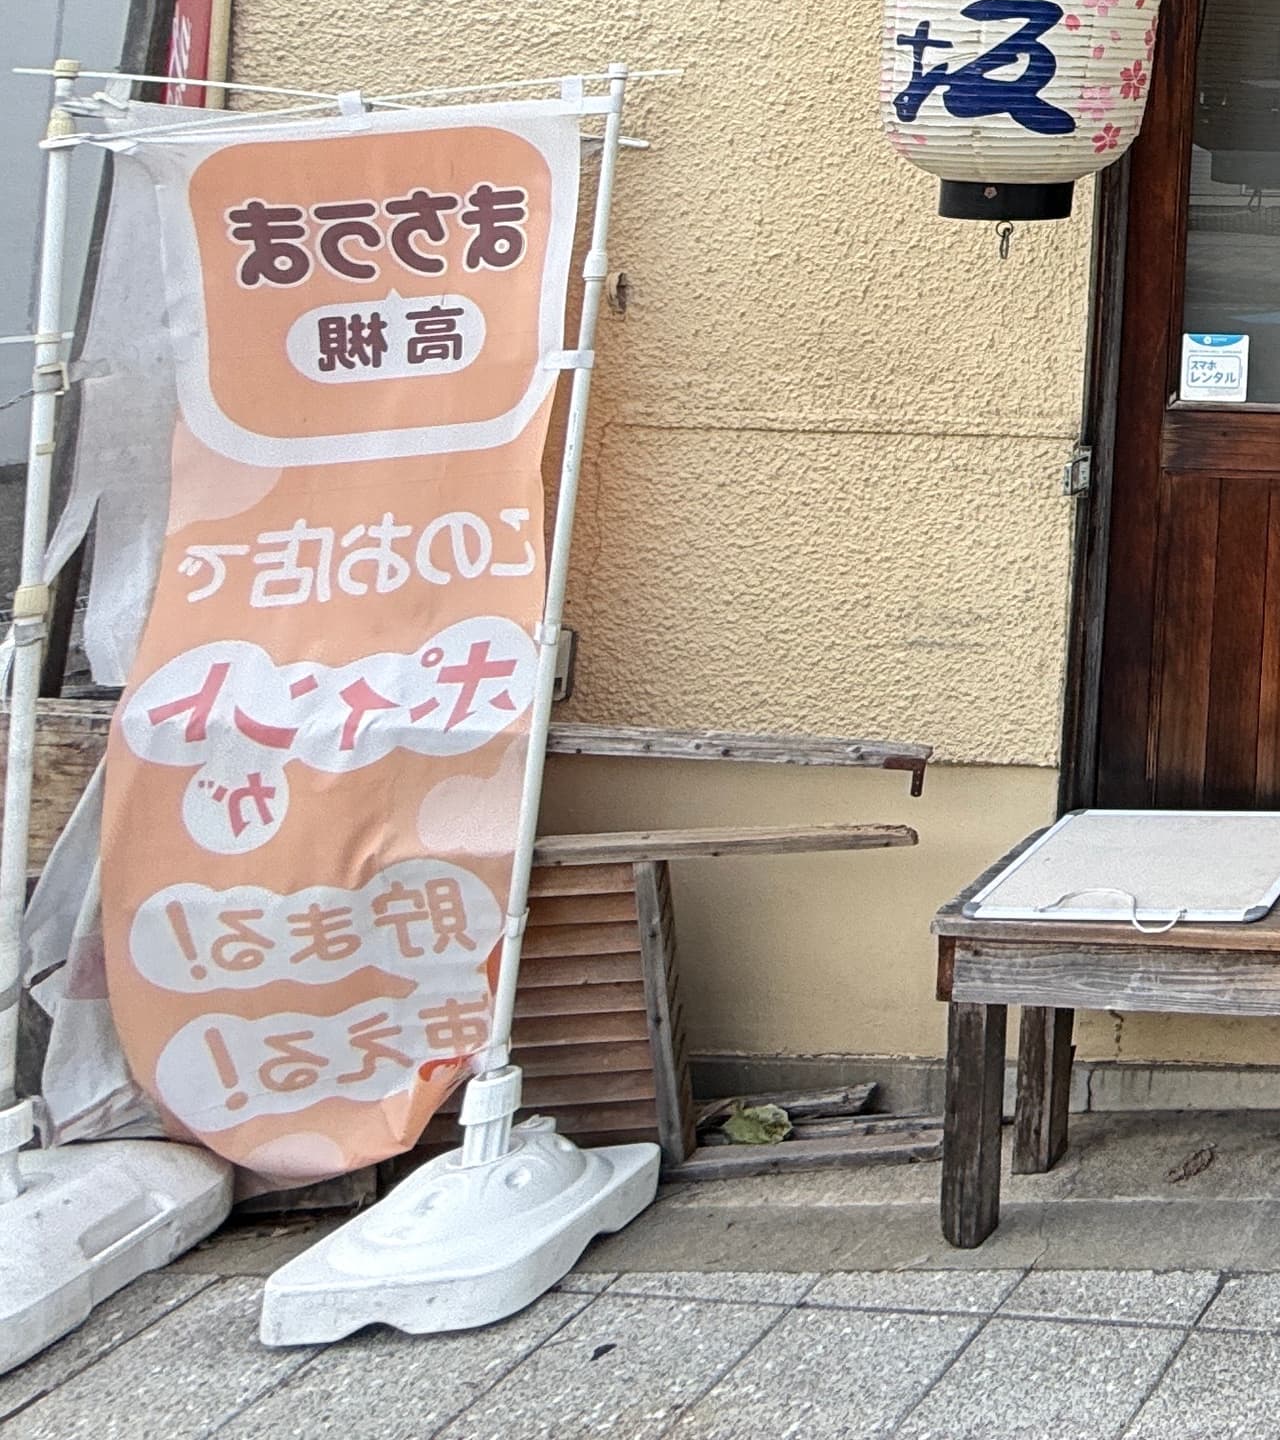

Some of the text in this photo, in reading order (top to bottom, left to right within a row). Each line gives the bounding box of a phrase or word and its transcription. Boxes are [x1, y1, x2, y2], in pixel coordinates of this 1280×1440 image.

[1190, 359, 1217, 371] スマホ
[1190, 371, 1237, 384] レンタル
